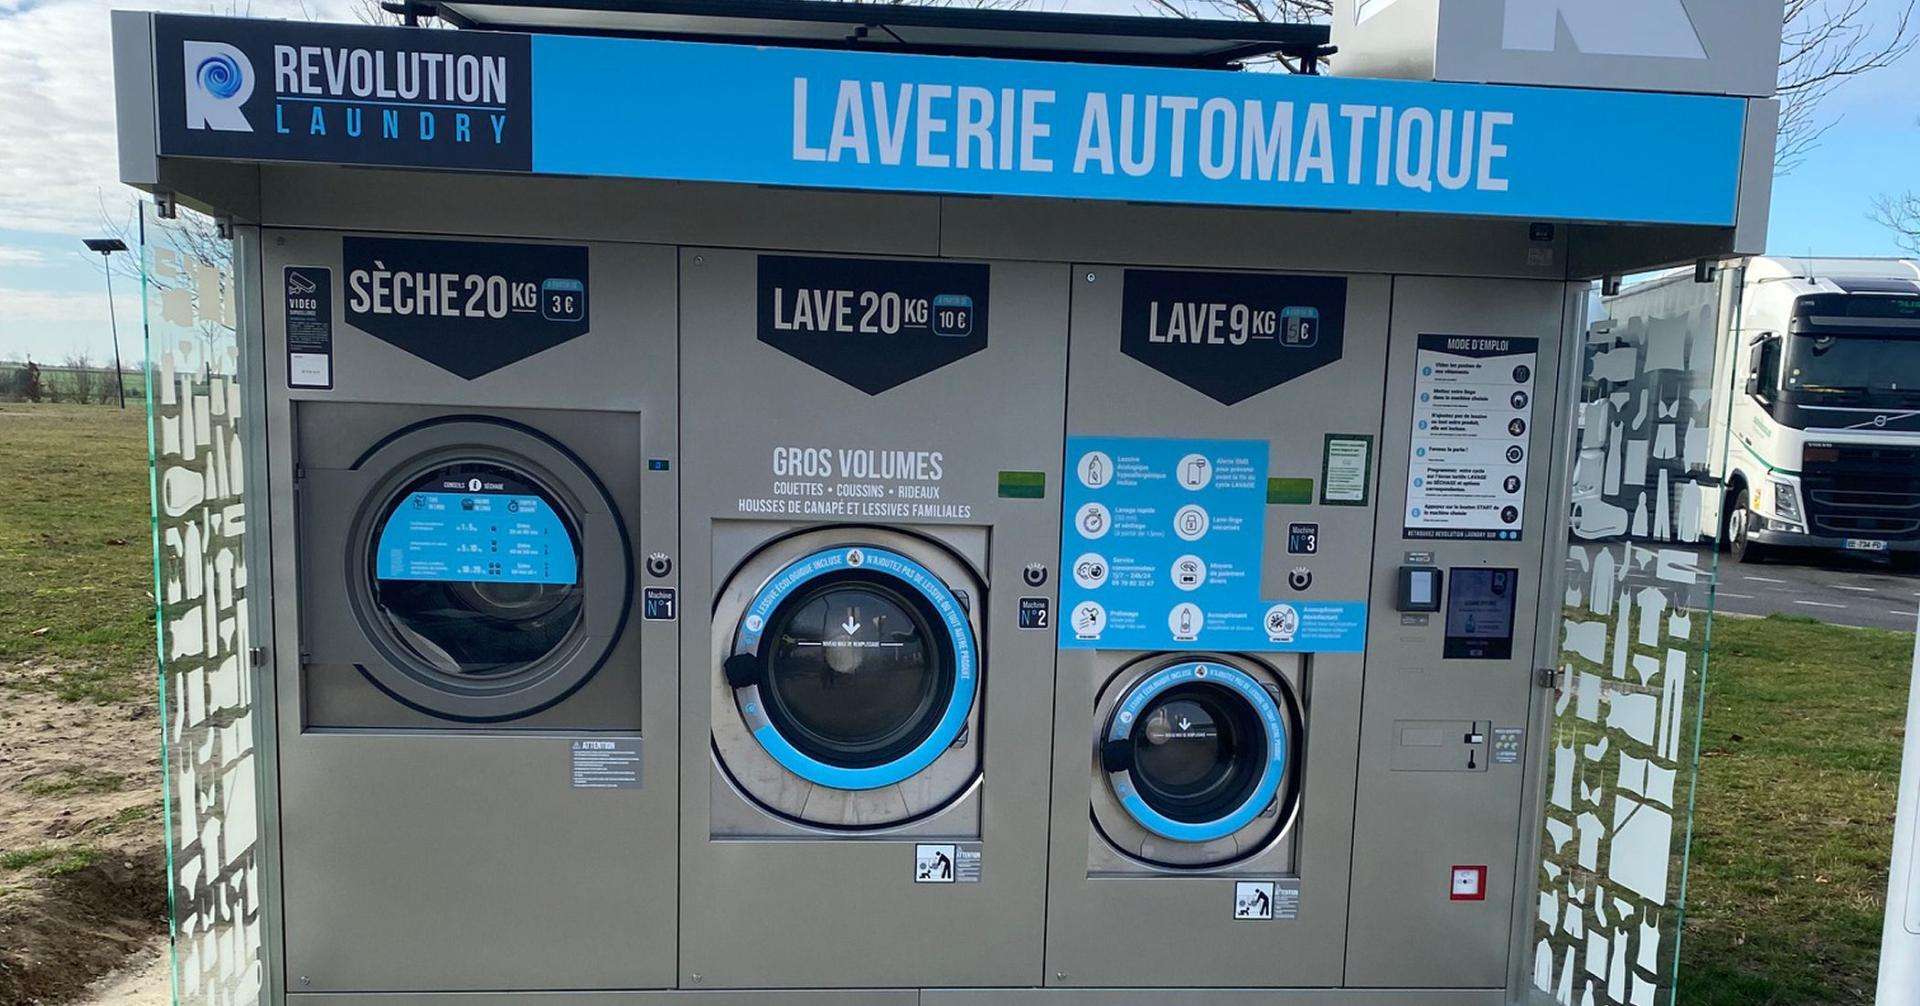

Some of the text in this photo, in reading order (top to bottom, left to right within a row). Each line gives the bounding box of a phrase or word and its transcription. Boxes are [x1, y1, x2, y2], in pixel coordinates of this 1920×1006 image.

[274, 44, 507, 104] REVOLUTION
[276, 104, 507, 144] LAUNDRY
[793, 77, 1515, 192] LAVERIE AUTOMATIQUE
[350, 260, 537, 319] SÈCHE 20 KG
[289, 298, 317, 310] VIDEO
[552, 296, 574, 314] 3 €
[774, 287, 928, 335] LAVE 20 KG
[940, 311, 966, 329] 10 €
[1149, 301, 1277, 346] LAVE 9 KG
[1301, 322, 1310, 340] €
[1447, 338, 1509, 351] MODE D'EMPLOI
[773, 446, 943, 481] GROS VOLUMES
[774, 481, 940, 500] COUETTES COUSSINS RIDEAUX
[738, 499, 971, 519] HOUSSES DE CANAPÉ ET LESSIVES FAMILIALES
[650, 552, 669, 560] START
[866, 554, 901, 574] N'AJOUTEZ
[902, 564, 916, 578] PAS
[1027, 562, 1045, 570] START
[756, 588, 780, 616] LESSIVE
[814, 555, 842, 569] INCLUSE
[914, 572, 924, 585] DE
[648, 591, 672, 599] Machine
[922, 578, 946, 603] LESSIVE
[1022, 601, 1045, 609] Machine
[944, 610, 961, 628] TOUT
[954, 627, 968, 650] AUTRE
[960, 650, 971, 681] PRODUIT
[582, 742, 616, 750] ATTENTION
